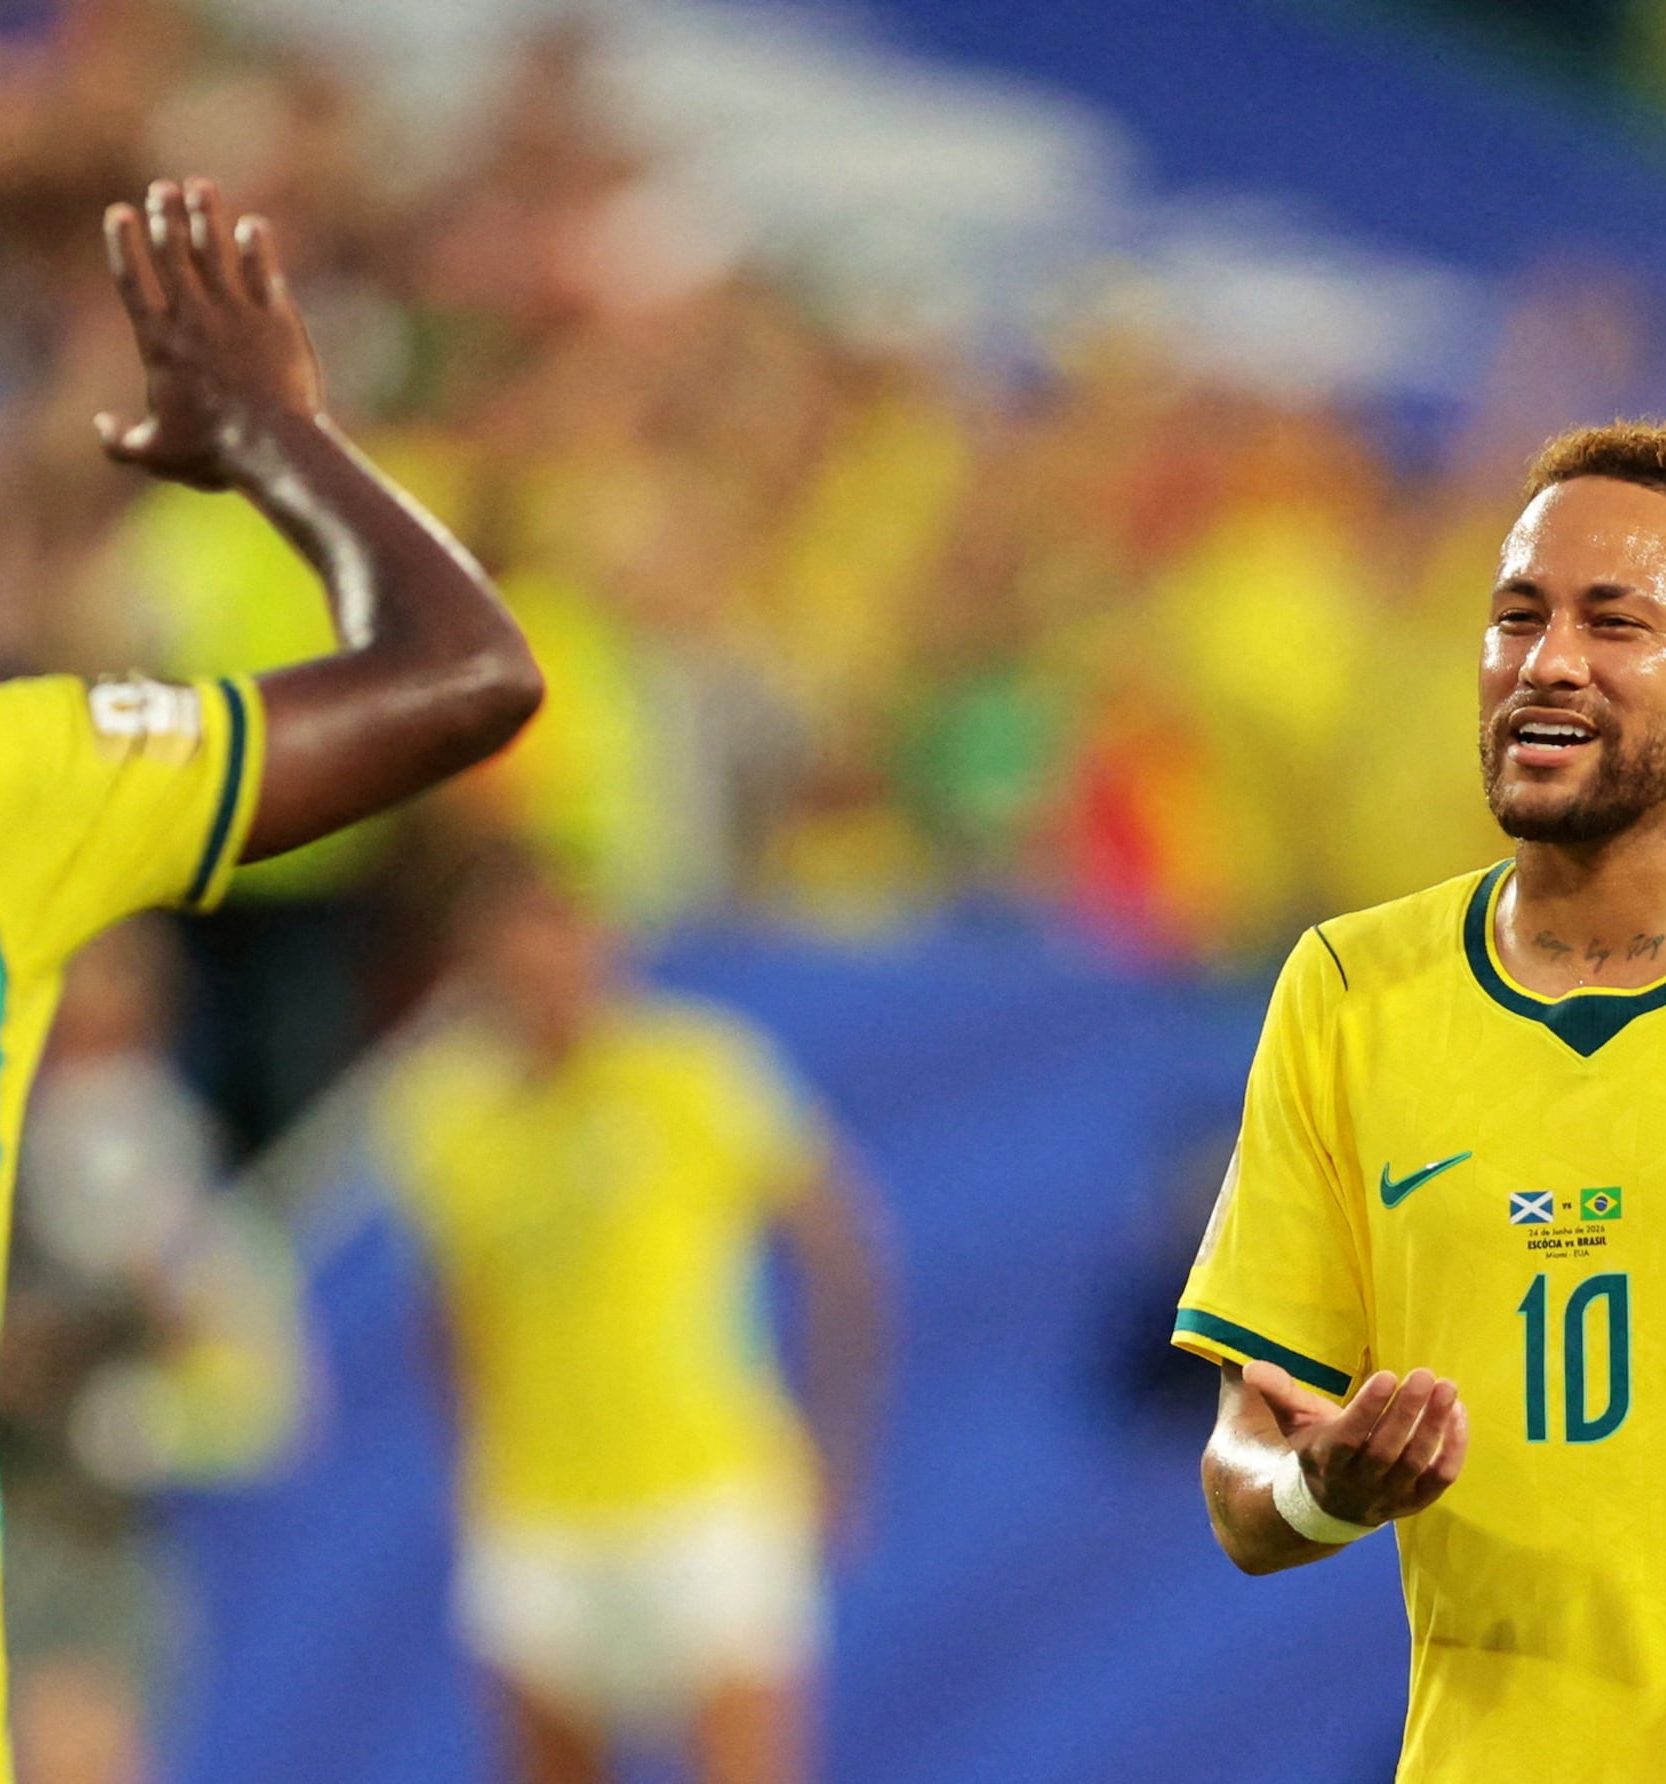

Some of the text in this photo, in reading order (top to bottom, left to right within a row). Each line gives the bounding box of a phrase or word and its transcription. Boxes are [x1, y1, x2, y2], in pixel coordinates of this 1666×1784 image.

[1562, 1202, 1572, 1210] vs
[1528, 1229, 1538, 1237] 24
[1541, 1228, 1550, 1236] de
[1575, 1226, 1584, 1234] de
[1587, 1225, 1605, 1233] 2026
[1527, 1236, 1607, 1250] ESCÓCIA vs BRASIL
[1573, 1249, 1589, 1257] EUA
[1515, 1271, 1630, 1445] 10
